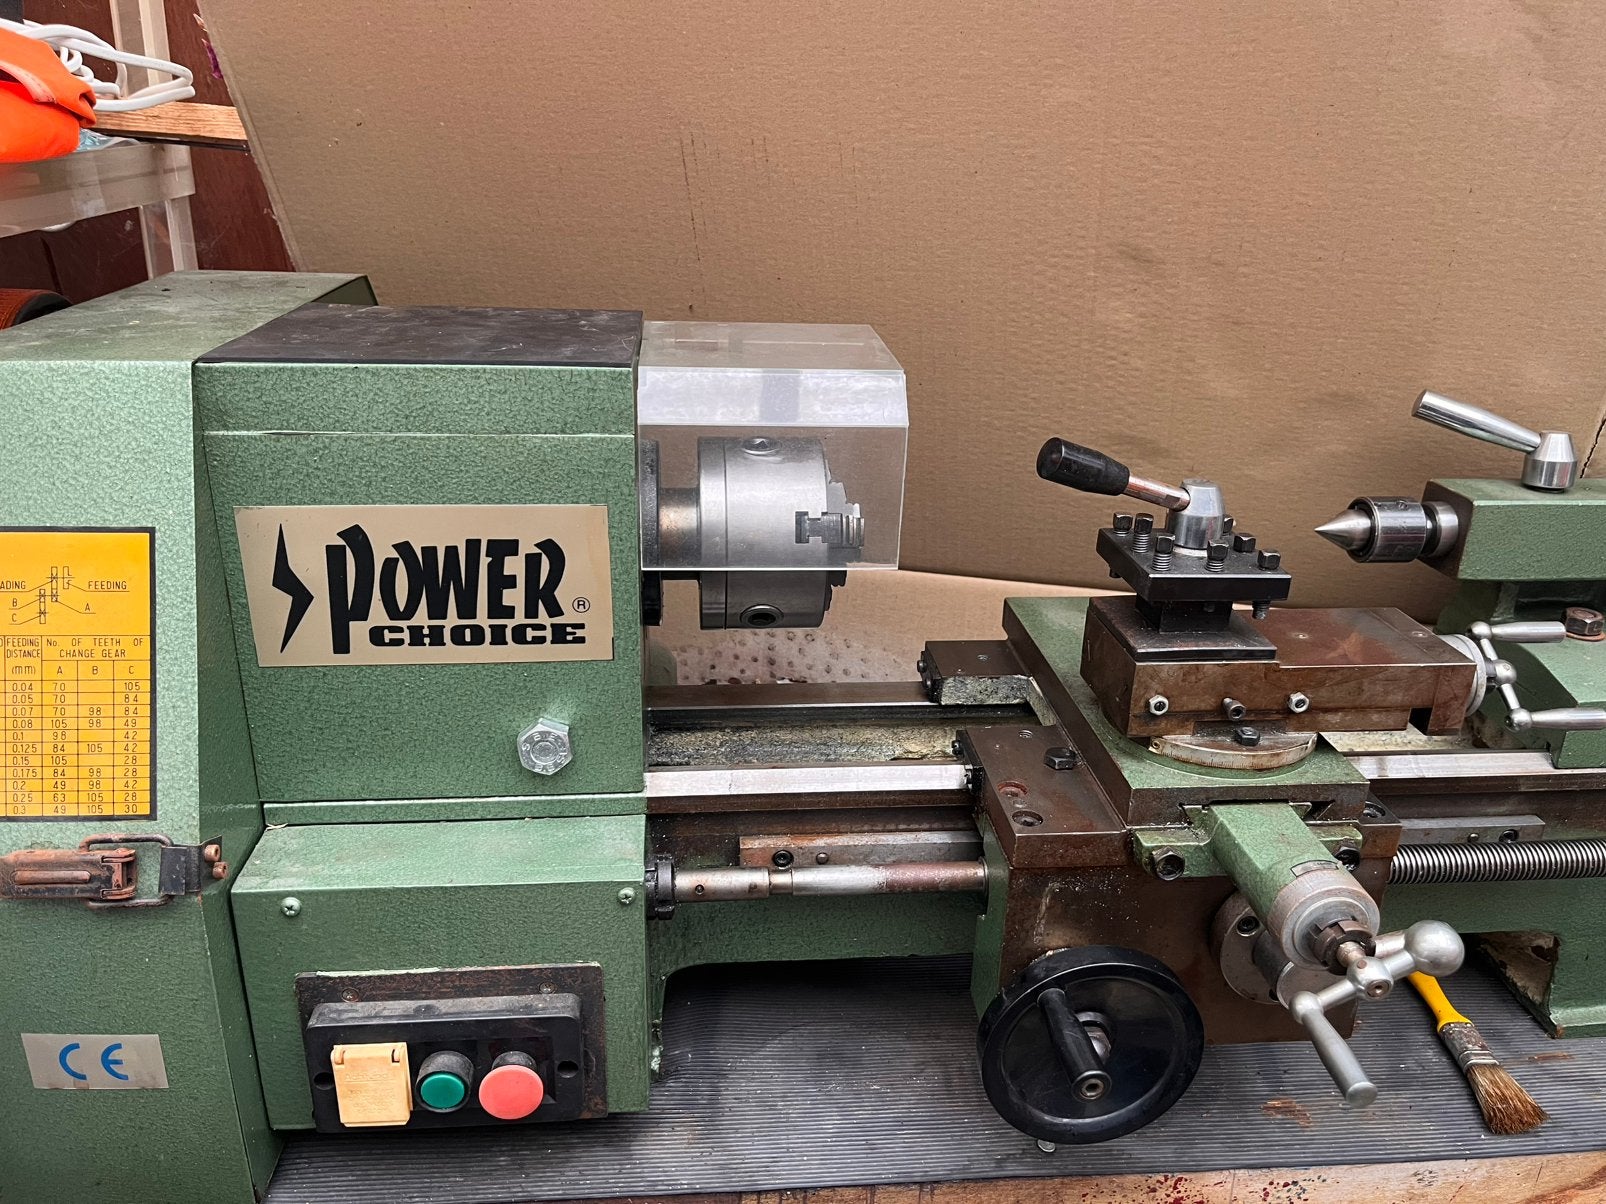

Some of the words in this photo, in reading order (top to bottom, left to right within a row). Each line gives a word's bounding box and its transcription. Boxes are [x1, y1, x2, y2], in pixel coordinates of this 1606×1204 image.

[88, 580, 127, 590] FEEDING
[325, 523, 566, 654] POWER
[12, 597, 18, 607] B
[84, 602, 91, 612] A
[11, 613, 17, 622] C
[368, 622, 586, 647] CHOICE
[6, 637, 40, 648] FEEDING
[71, 637, 83, 647] OF
[93, 637, 121, 647] TEETH
[133, 637, 144, 647] OF
[6, 648, 41, 659] DISTANCE
[59, 649, 96, 659] CHANGE
[101, 649, 126, 658] GEAR
[56, 665, 63, 675] A
[92, 665, 99, 676] B
[128, 665, 135, 675] C
[12, 682, 33, 692] 0.04
[53, 682, 66, 692] 70
[124, 681, 141, 691] 105
[12, 694, 34, 704] 0.05
[53, 694, 66, 704] 70
[124, 694, 138, 703] 84
[12, 707, 34, 717] 0.07
[53, 706, 66, 716] 70
[88, 706, 102, 716] 98
[124, 706, 138, 716] 84
[12, 719, 33, 729] 0.08
[51, 719, 68, 728] 105
[88, 718, 101, 728] 98
[124, 718, 137, 728] 49
[12, 731, 24, 741] 0.1
[53, 731, 67, 740] 98
[123, 730, 138, 740] 42
[12, 743, 38, 753] 0.125
[52, 743, 65, 753] 84
[87, 743, 103, 753] 105
[123, 743, 138, 752] 42
[12, 756, 30, 765] 0.15
[51, 755, 68, 765] 105
[123, 755, 137, 765] 28
[12, 768, 38, 778] 0.175
[53, 768, 66, 777] 84
[88, 768, 102, 777] 98
[123, 768, 138, 777] 28
[12, 780, 26, 791] 0.2
[53, 780, 66, 790] 49
[88, 780, 101, 790] 98
[123, 780, 138, 789] 42
[12, 793, 33, 803] 0.25
[53, 793, 66, 802] 63
[87, 792, 104, 802] 105
[124, 792, 137, 801] 28
[13, 805, 26, 815] 0.3
[53, 804, 66, 814] 49
[87, 804, 103, 814] 105
[124, 804, 138, 814] 30
[58, 1042, 129, 1081] CE
